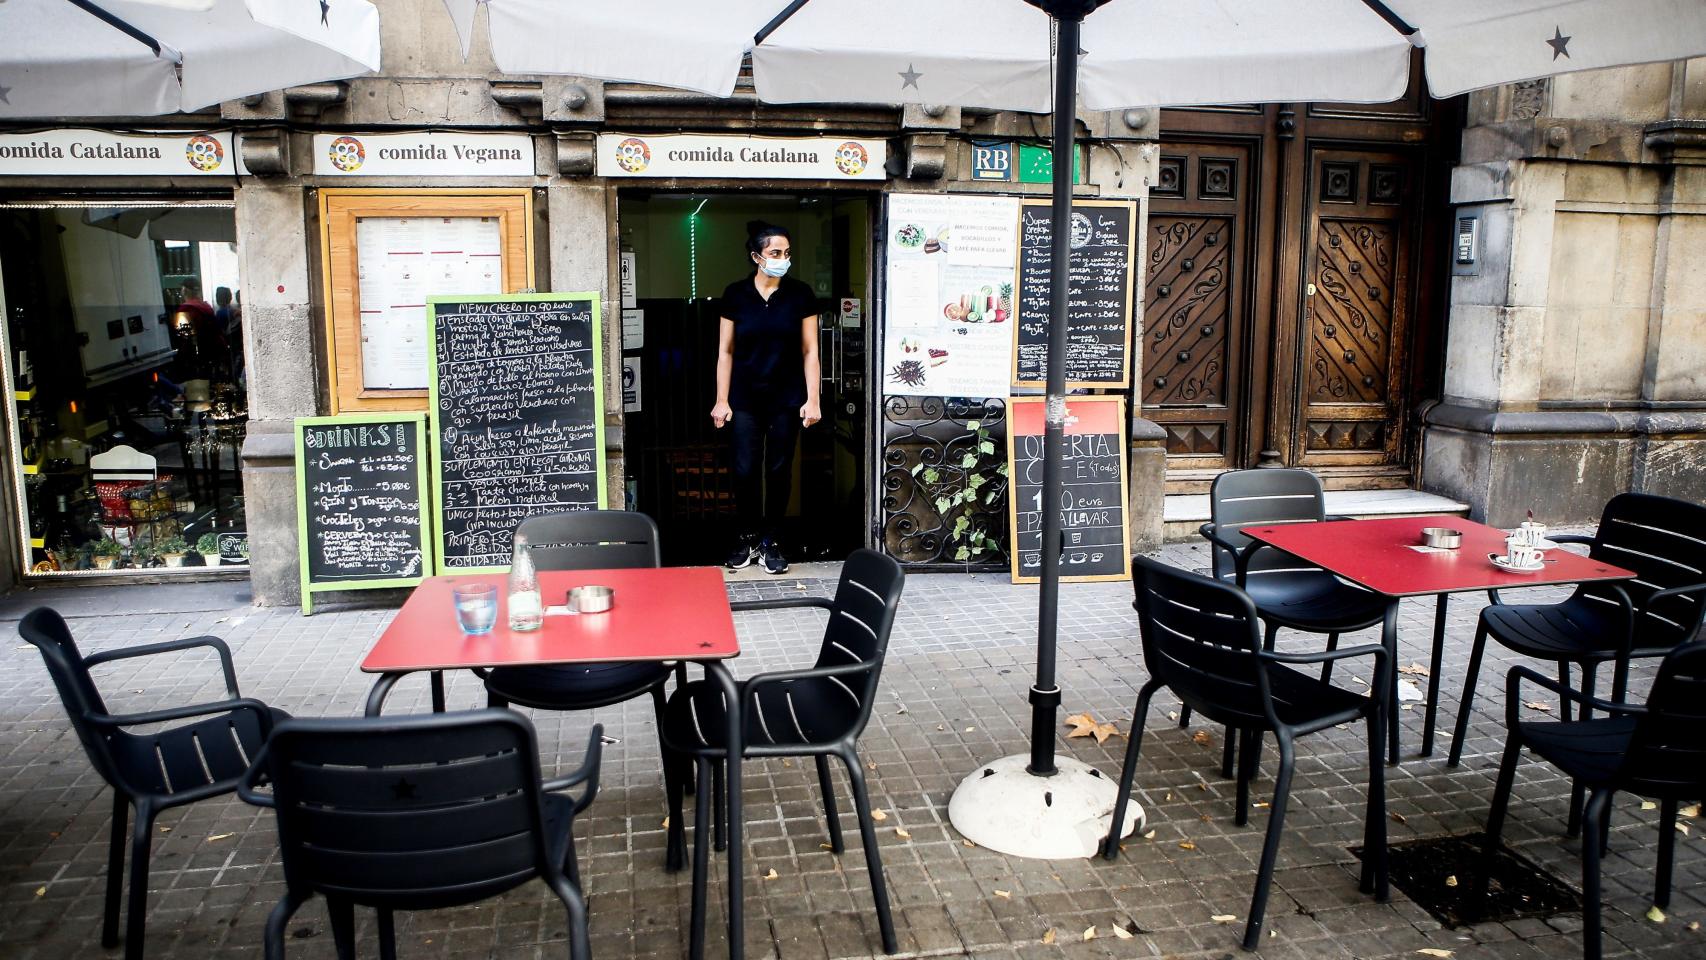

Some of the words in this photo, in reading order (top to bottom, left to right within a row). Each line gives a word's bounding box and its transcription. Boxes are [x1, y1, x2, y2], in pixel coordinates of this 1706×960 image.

[70, 142, 162, 159] Catalana
[378, 144, 448, 160] comida
[453, 144, 523, 164] Vegana
[667, 146, 734, 162] comida
[739, 147, 820, 164] Catalana
[975, 148, 1009, 171] RB
